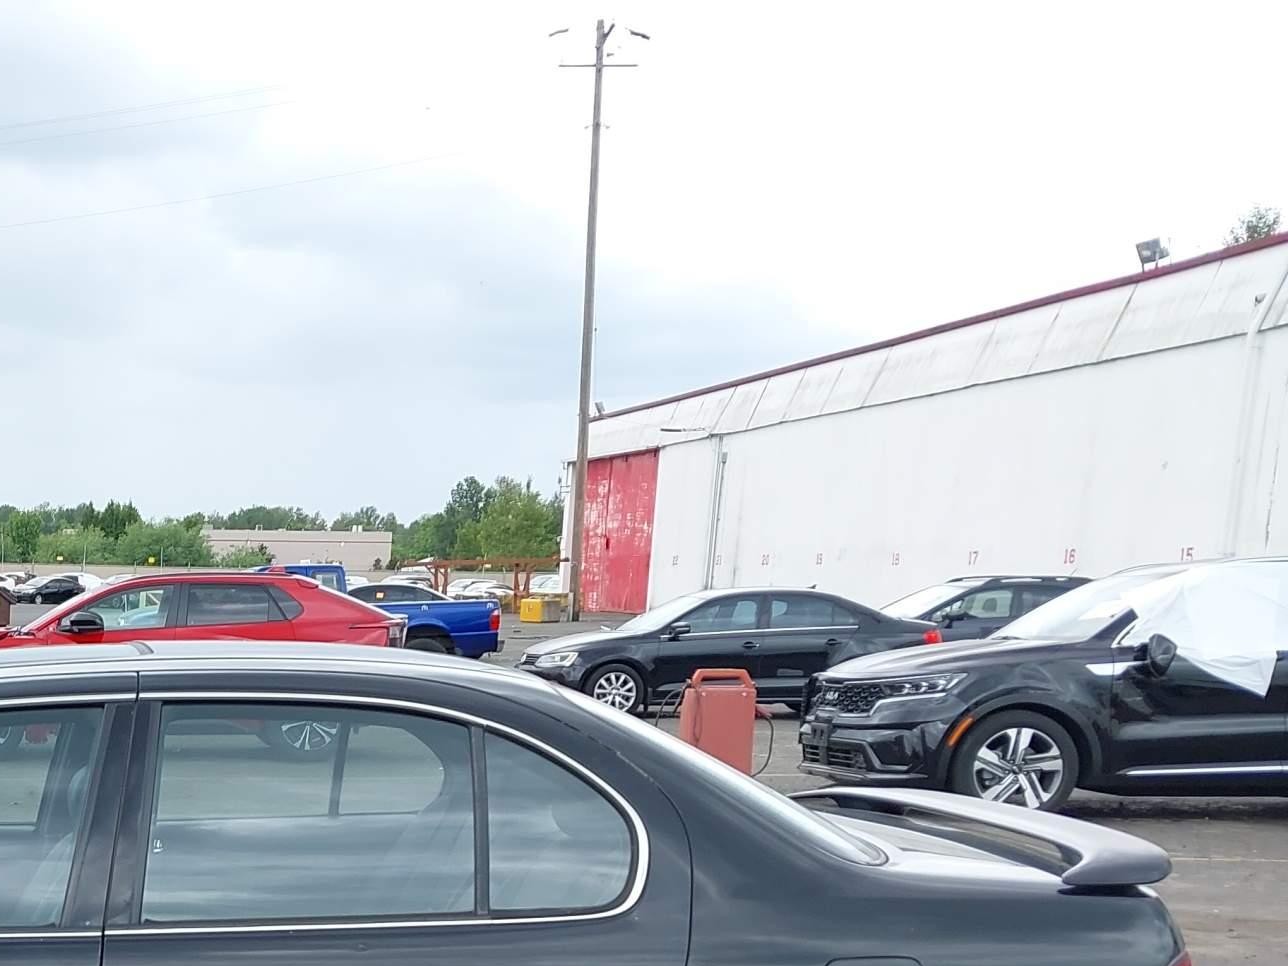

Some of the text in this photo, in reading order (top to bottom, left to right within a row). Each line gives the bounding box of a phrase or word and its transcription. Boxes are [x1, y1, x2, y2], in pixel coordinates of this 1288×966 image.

[968, 550, 979, 566] 17
[1063, 548, 1076, 565] 16
[1180, 546, 1194, 561] 15
